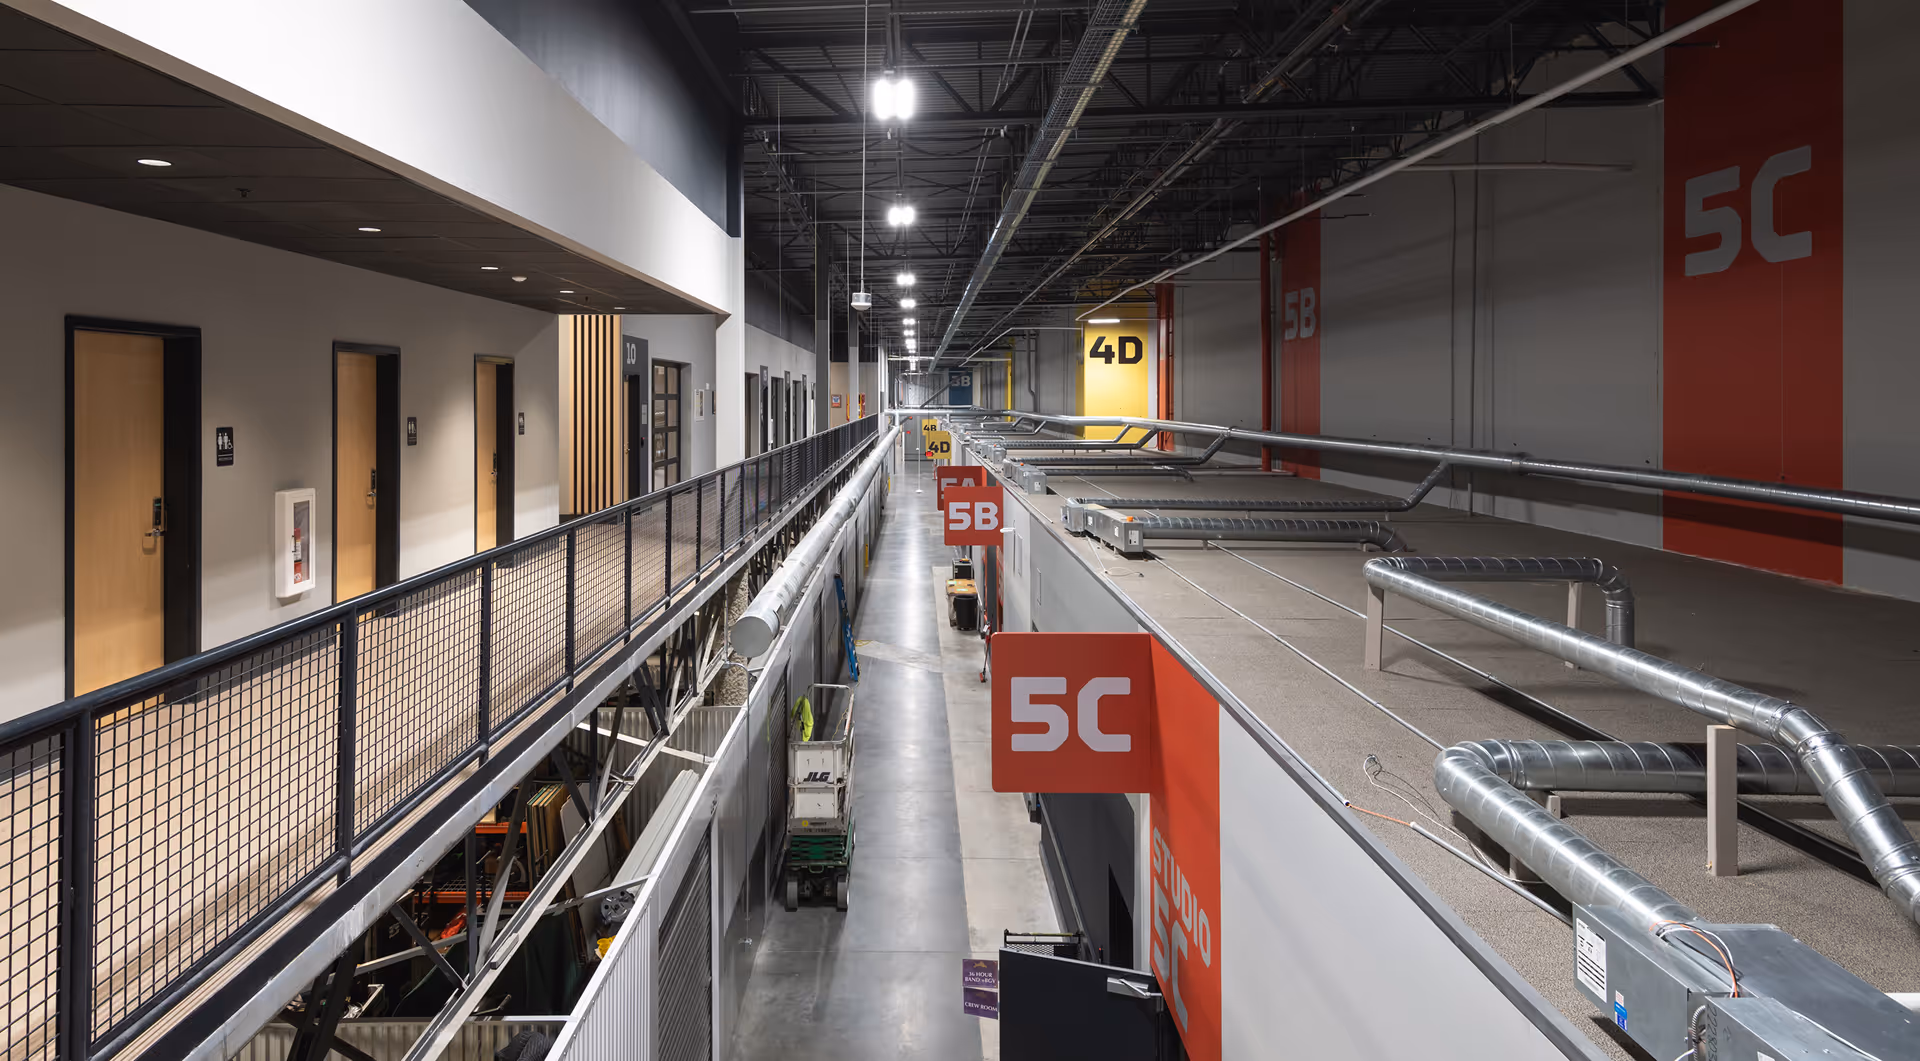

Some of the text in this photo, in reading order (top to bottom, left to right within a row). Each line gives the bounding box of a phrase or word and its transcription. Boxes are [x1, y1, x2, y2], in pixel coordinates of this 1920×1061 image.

[1685, 144, 1812, 277] 5C
[1285, 287, 1317, 340] 5B
[626, 342, 637, 365] 10
[1089, 336, 1143, 364] 4D
[951, 375, 971, 387] 3B
[923, 424, 937, 432] 4B
[929, 441, 951, 454] 4D
[949, 502, 998, 530] 5B
[1011, 677, 1131, 752] 5C
[803, 772, 831, 782] JLG
[1153, 826, 1211, 968] STUDIO
[1154, 876, 1188, 1033] 5C
